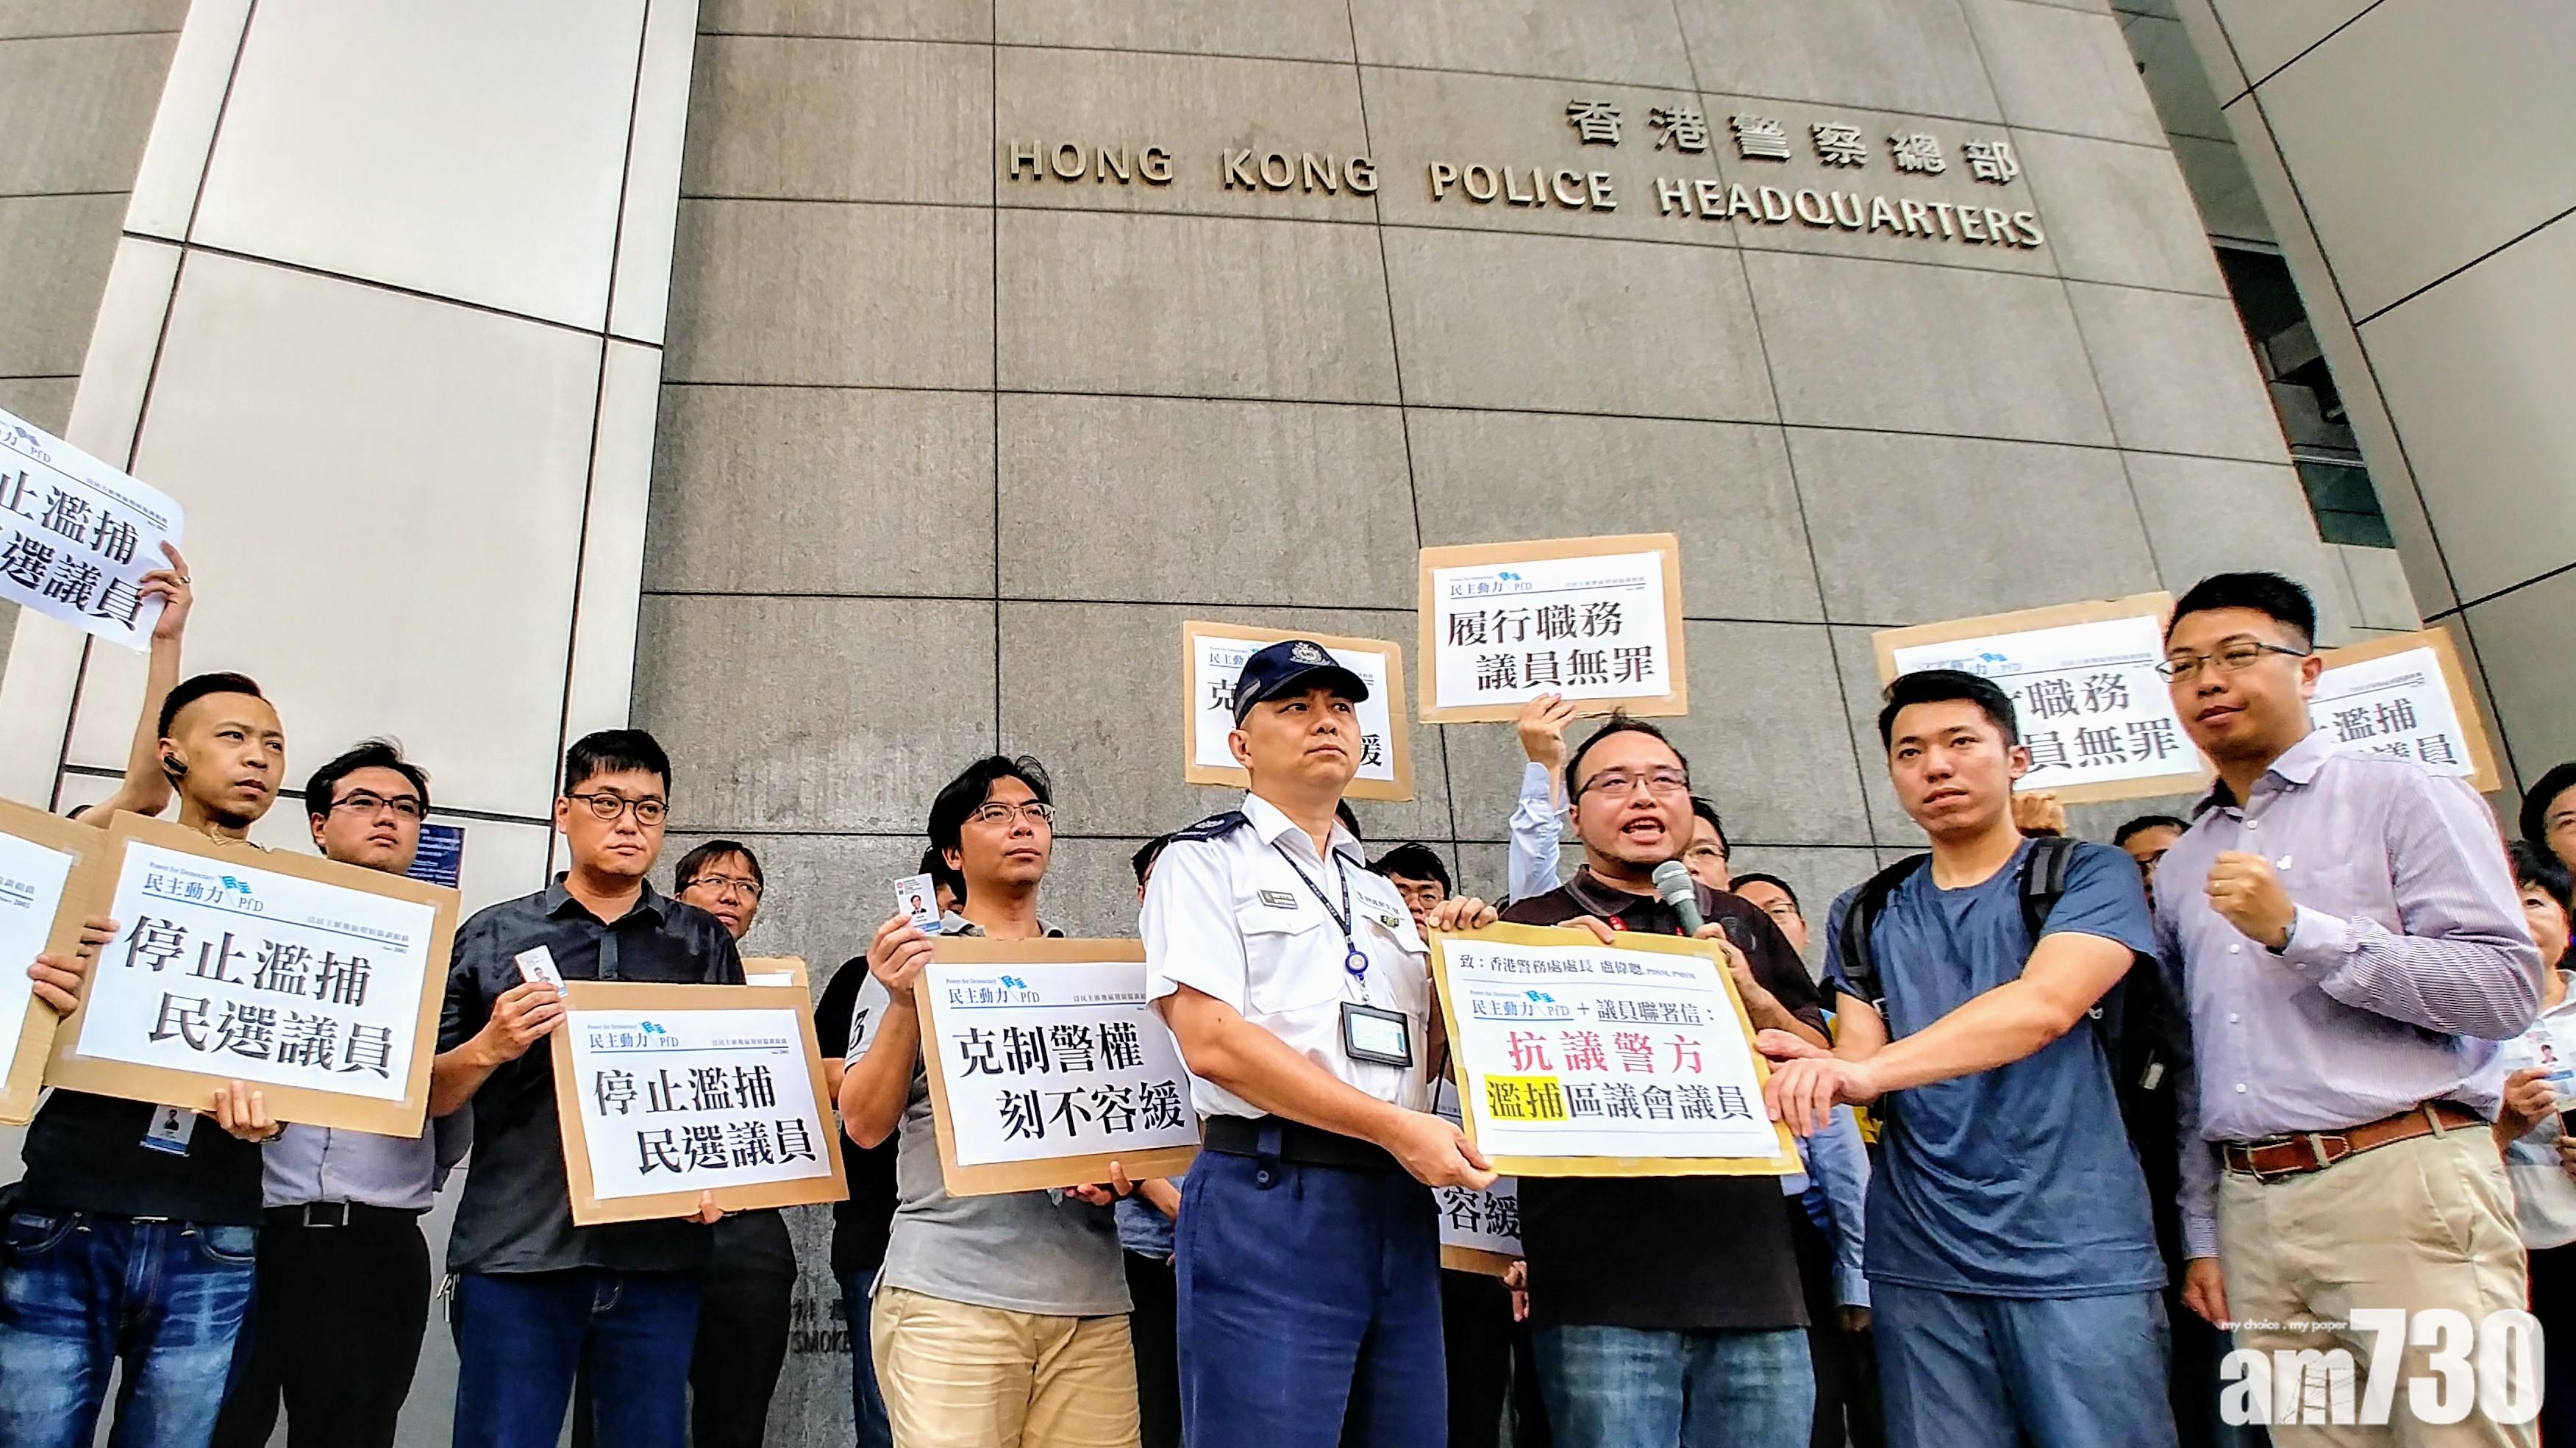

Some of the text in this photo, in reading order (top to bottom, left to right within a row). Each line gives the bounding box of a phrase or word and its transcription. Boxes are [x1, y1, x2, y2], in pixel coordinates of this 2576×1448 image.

[1568, 99, 2021, 184] 香港警察總部
[1009, 138, 2045, 249] HONG KONG POLICE HEADQUARTERS
[0, 525, 144, 631] 選議員
[1447, 601, 1623, 647] 履行職務
[1210, 652, 1250, 666] 民主動
[1476, 645, 1656, 691] 議員無罪
[2008, 673, 2129, 720] 職務
[2026, 717, 2180, 774] 員無罪
[144, 873, 224, 904] 民主動力
[238, 896, 264, 913] PfD
[124, 914, 373, 1007] 停止濫捕
[949, 988, 1008, 1005] 民主動力
[1020, 992, 1040, 1003] PfD
[1472, 999, 1534, 1017] 民主動力
[148, 991, 394, 1080] 民選議員
[589, 1032, 648, 1049] 民主動力
[660, 1036, 679, 1048] PfD
[952, 1021, 1144, 1078] 克制警權
[1507, 1030, 1702, 1074] 抗議警方
[593, 1064, 776, 1117] 停止濫捕
[996, 1079, 1185, 1142] 刻不容緩
[1487, 1081, 1755, 1121] 濫捕區議會議員
[637, 1117, 817, 1176] 民選議員
